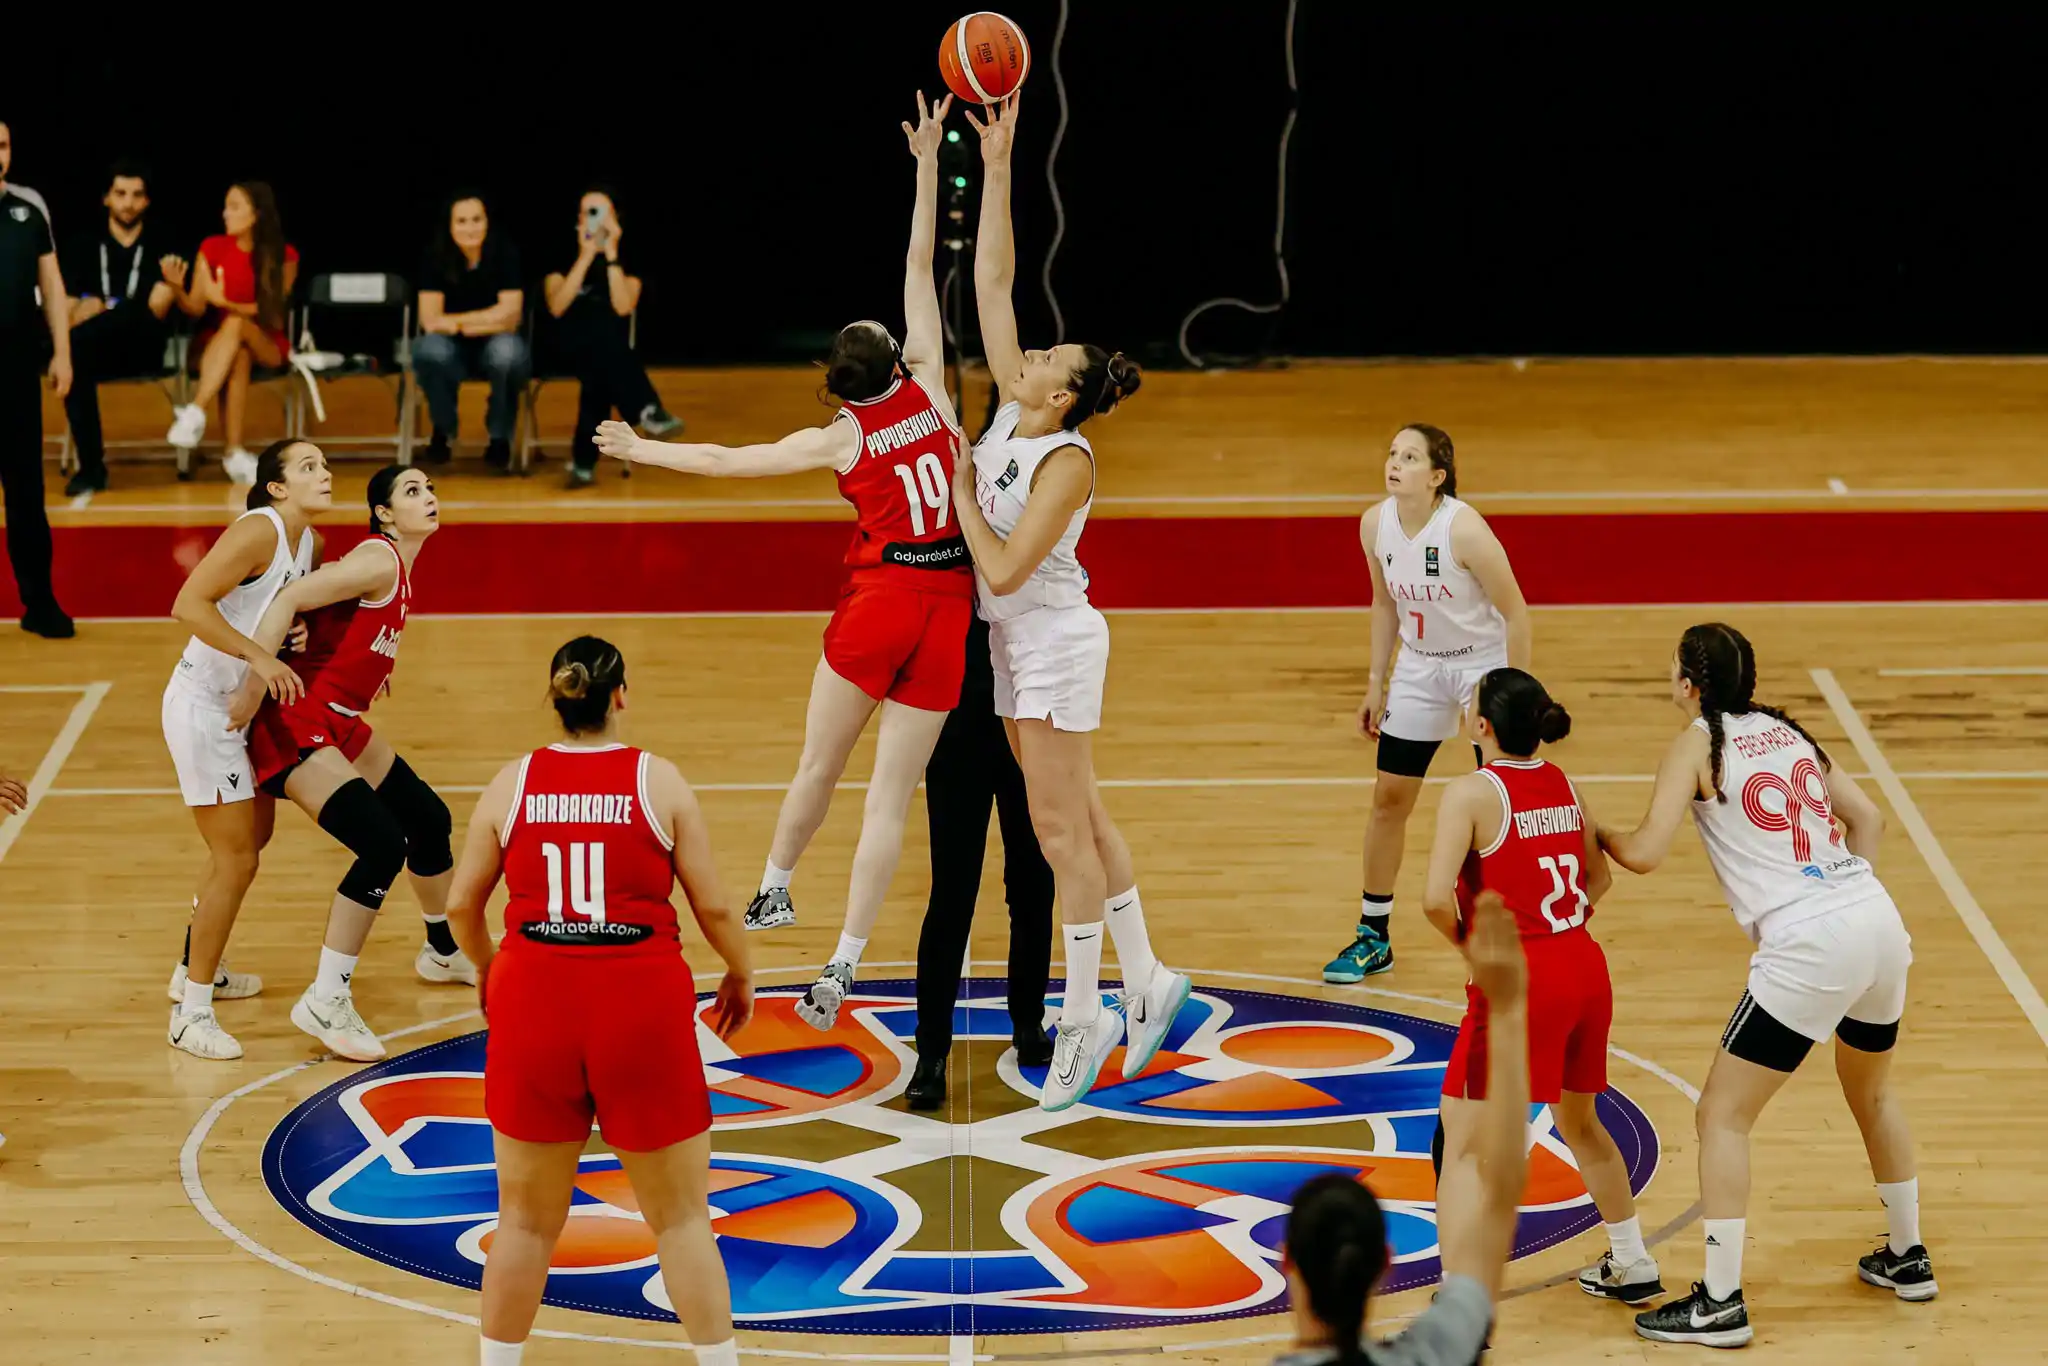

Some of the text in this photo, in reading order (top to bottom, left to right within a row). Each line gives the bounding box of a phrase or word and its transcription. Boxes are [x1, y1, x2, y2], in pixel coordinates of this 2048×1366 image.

[981, 42, 994, 63] FIBA
[866, 406, 942, 459] PAPUASHVILI
[893, 452, 949, 537] 19
[893, 545, 964, 565] adjarabet.c
[1408, 610, 1424, 640] 7
[525, 793, 633, 825] BARBAKADZE
[1741, 757, 1841, 863] 99
[541, 842, 606, 923] 14
[1537, 853, 1589, 934] 23
